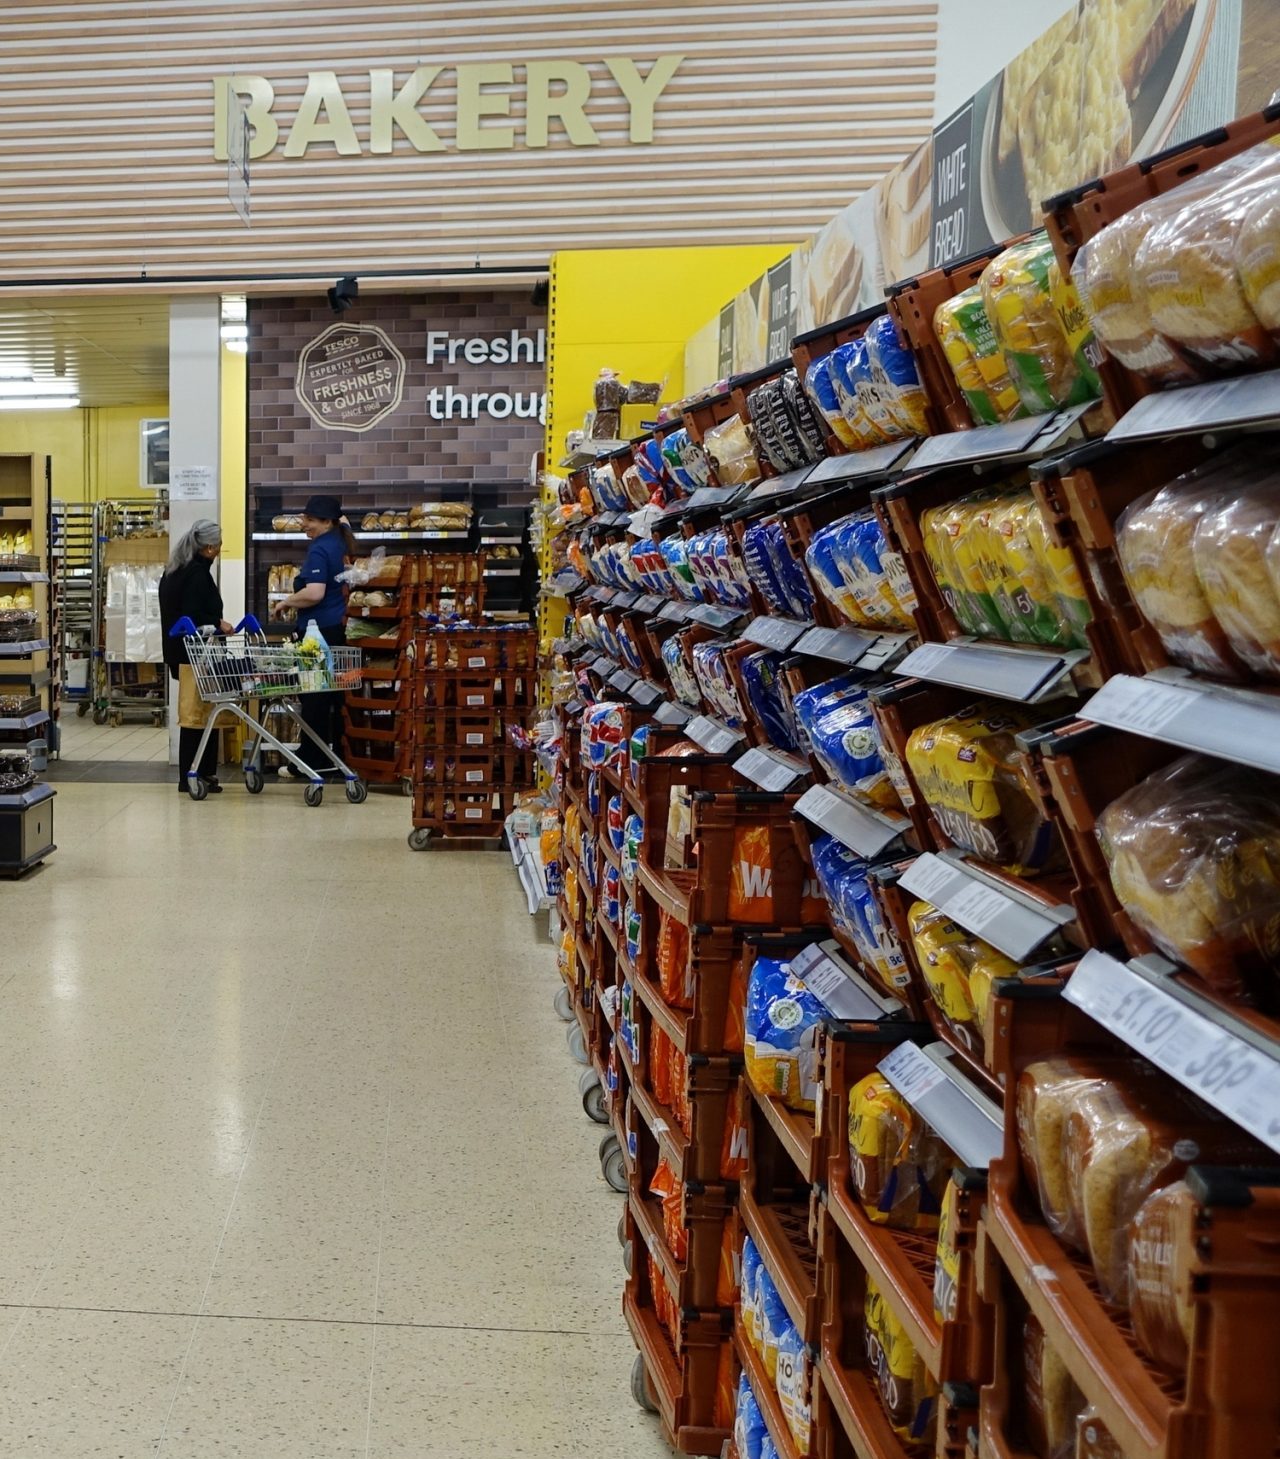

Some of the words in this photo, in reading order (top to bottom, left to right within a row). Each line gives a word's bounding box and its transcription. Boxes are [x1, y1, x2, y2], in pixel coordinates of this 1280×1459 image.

[213, 55, 687, 161] BAKERY
[937, 143, 968, 207] WHITE
[934, 207, 965, 268] BREAD
[323, 336, 359, 352] TESCO
[426, 329, 546, 365] Freshl
[309, 360, 352, 379] EXPERTLY
[354, 350, 384, 365] BAKED
[313, 366, 393, 402] FRESHNESS
[321, 402, 332, 414] &
[334, 382, 392, 409] QUALITY
[341, 407, 363, 420] SINCE
[1113, 989, 1181, 1045] £1.10
